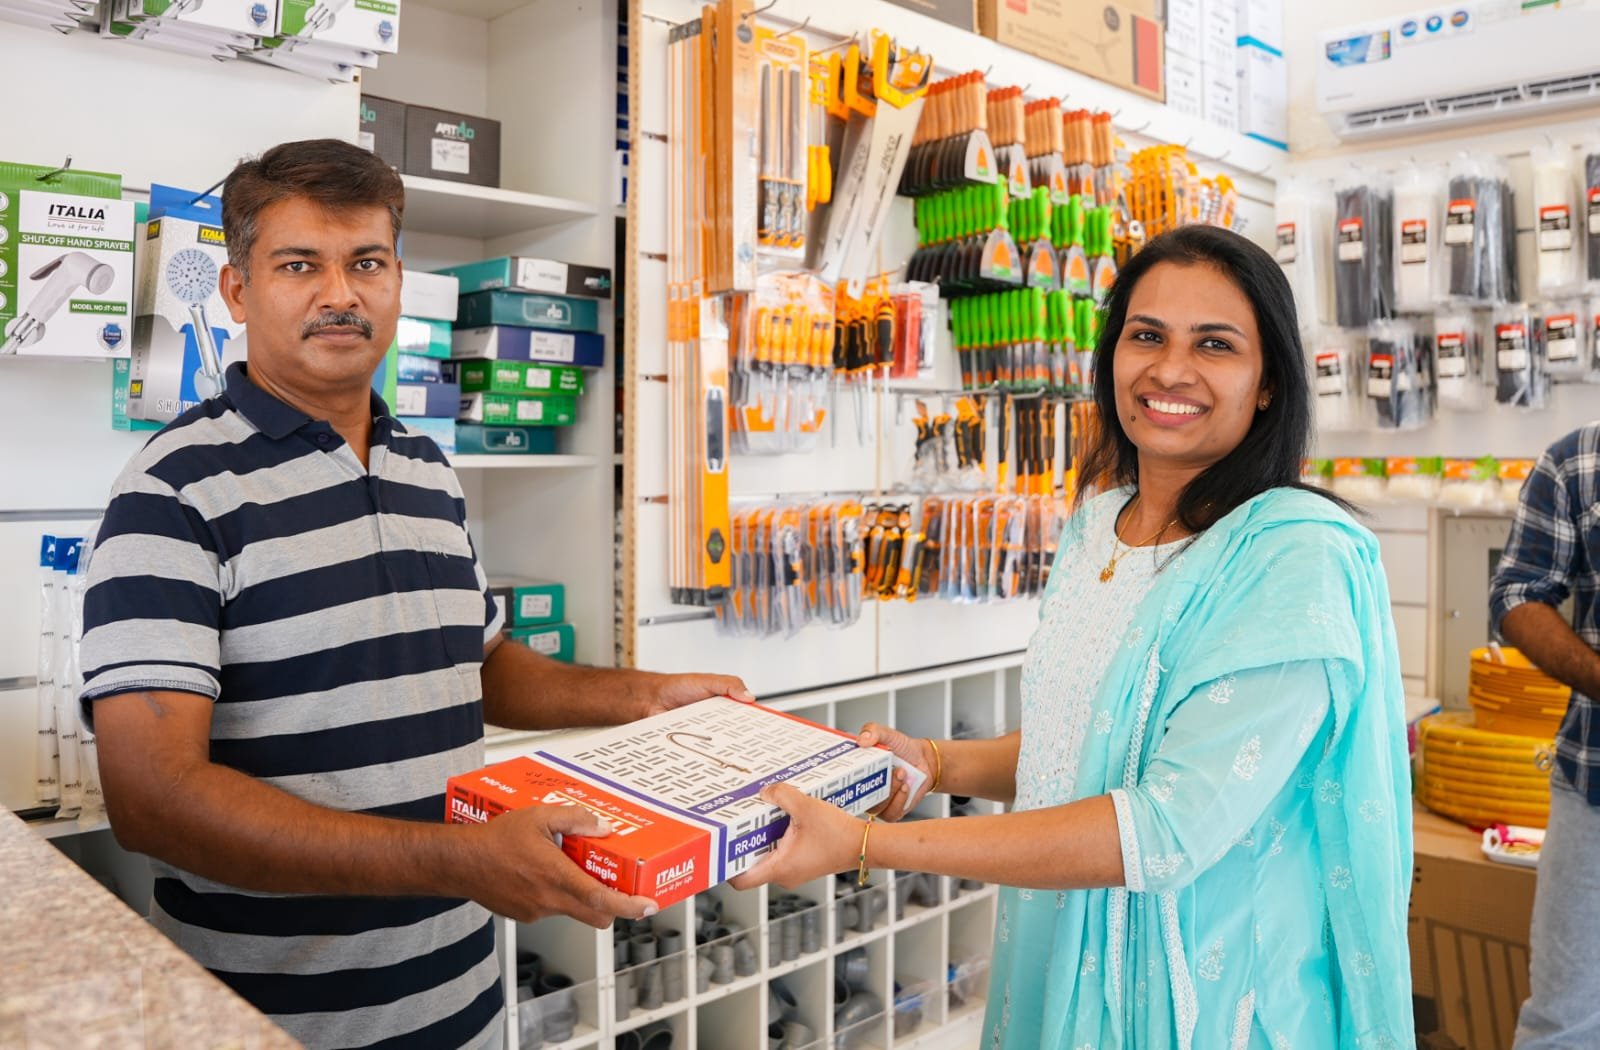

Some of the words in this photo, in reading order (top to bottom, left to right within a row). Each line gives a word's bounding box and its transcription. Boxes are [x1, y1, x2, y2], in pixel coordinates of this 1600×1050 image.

[48, 204, 105, 219] ITALIA
[22, 234, 66, 245] SHUT-OFF
[67, 238, 92, 248] HAND
[94, 240, 130, 250] SPRAYER
[201, 228, 225, 242] ITALI
[697, 795, 735, 811] RR-004
[819, 742, 855, 760] Faucet
[452, 798, 488, 823] ITALIA
[734, 832, 767, 855] RR-004
[855, 773, 884, 797] Faucet
[585, 859, 618, 881] Single
[655, 858, 695, 885] ITALIA
